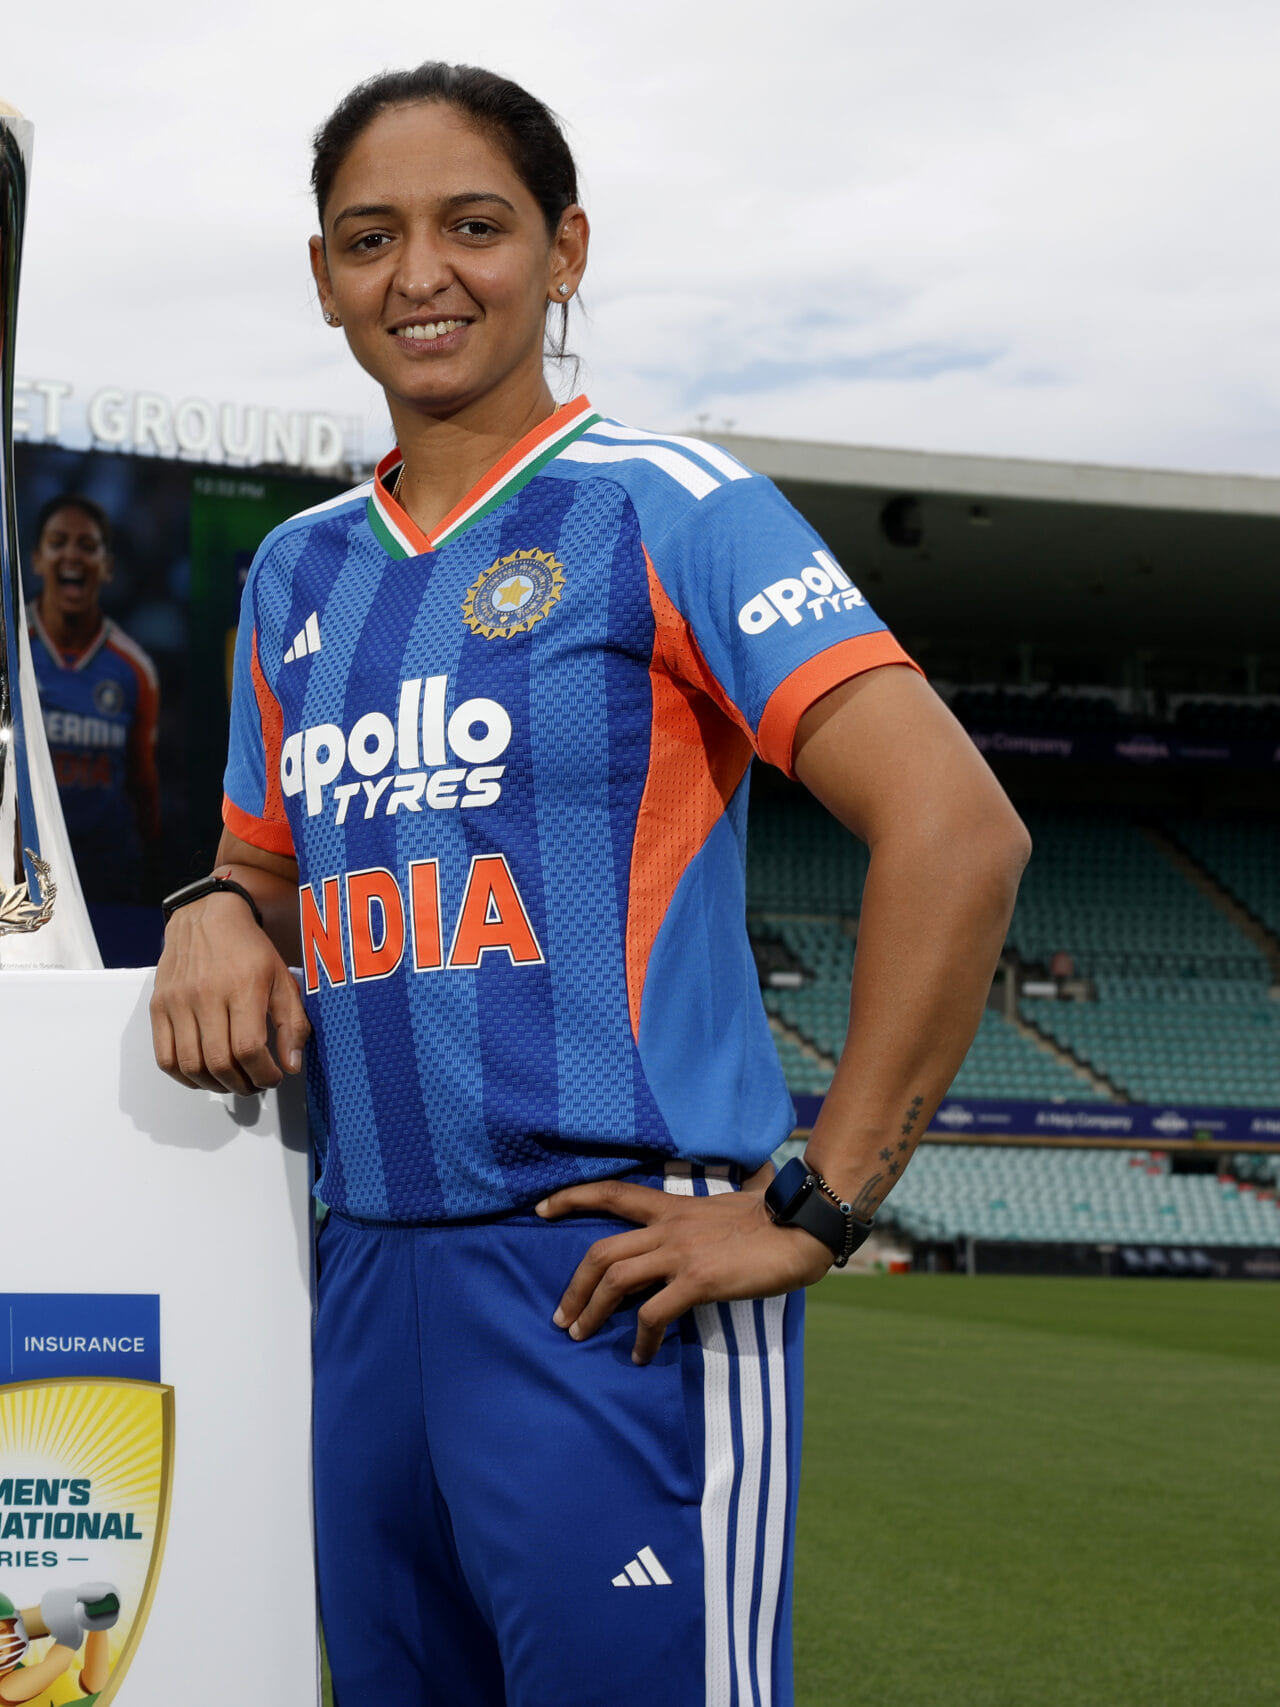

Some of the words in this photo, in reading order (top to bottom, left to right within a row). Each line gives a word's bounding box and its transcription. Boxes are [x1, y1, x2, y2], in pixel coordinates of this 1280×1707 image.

[88, 386, 345, 468] GROUND
[738, 549, 853, 635] apol
[806, 586, 866, 621] TYR
[55, 752, 112, 788] DIA
[280, 674, 512, 817] apollo
[333, 765, 506, 826] TYRES
[298, 853, 546, 995] NDIA
[24, 1337, 145, 1353] INSURANCE
